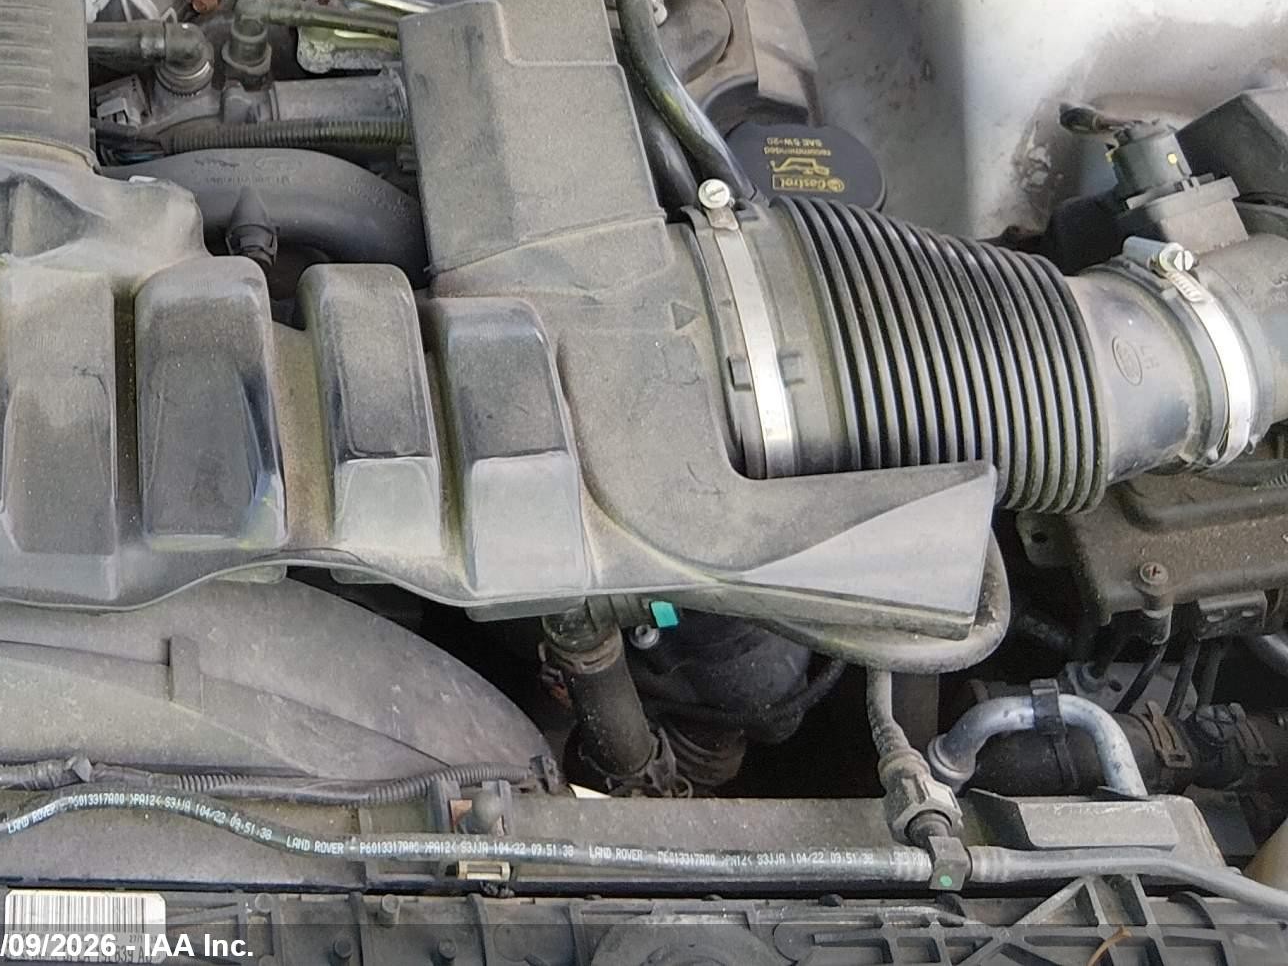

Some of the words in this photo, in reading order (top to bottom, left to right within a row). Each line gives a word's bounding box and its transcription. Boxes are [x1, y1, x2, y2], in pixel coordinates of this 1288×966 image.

[779, 176, 827, 190] Castrol
[32, 804, 57, 823] ROVER
[286, 835, 311, 851] LAND
[314, 840, 345, 855] ROVER
[588, 845, 612, 860] LAND
[615, 846, 644, 862] ROVER
